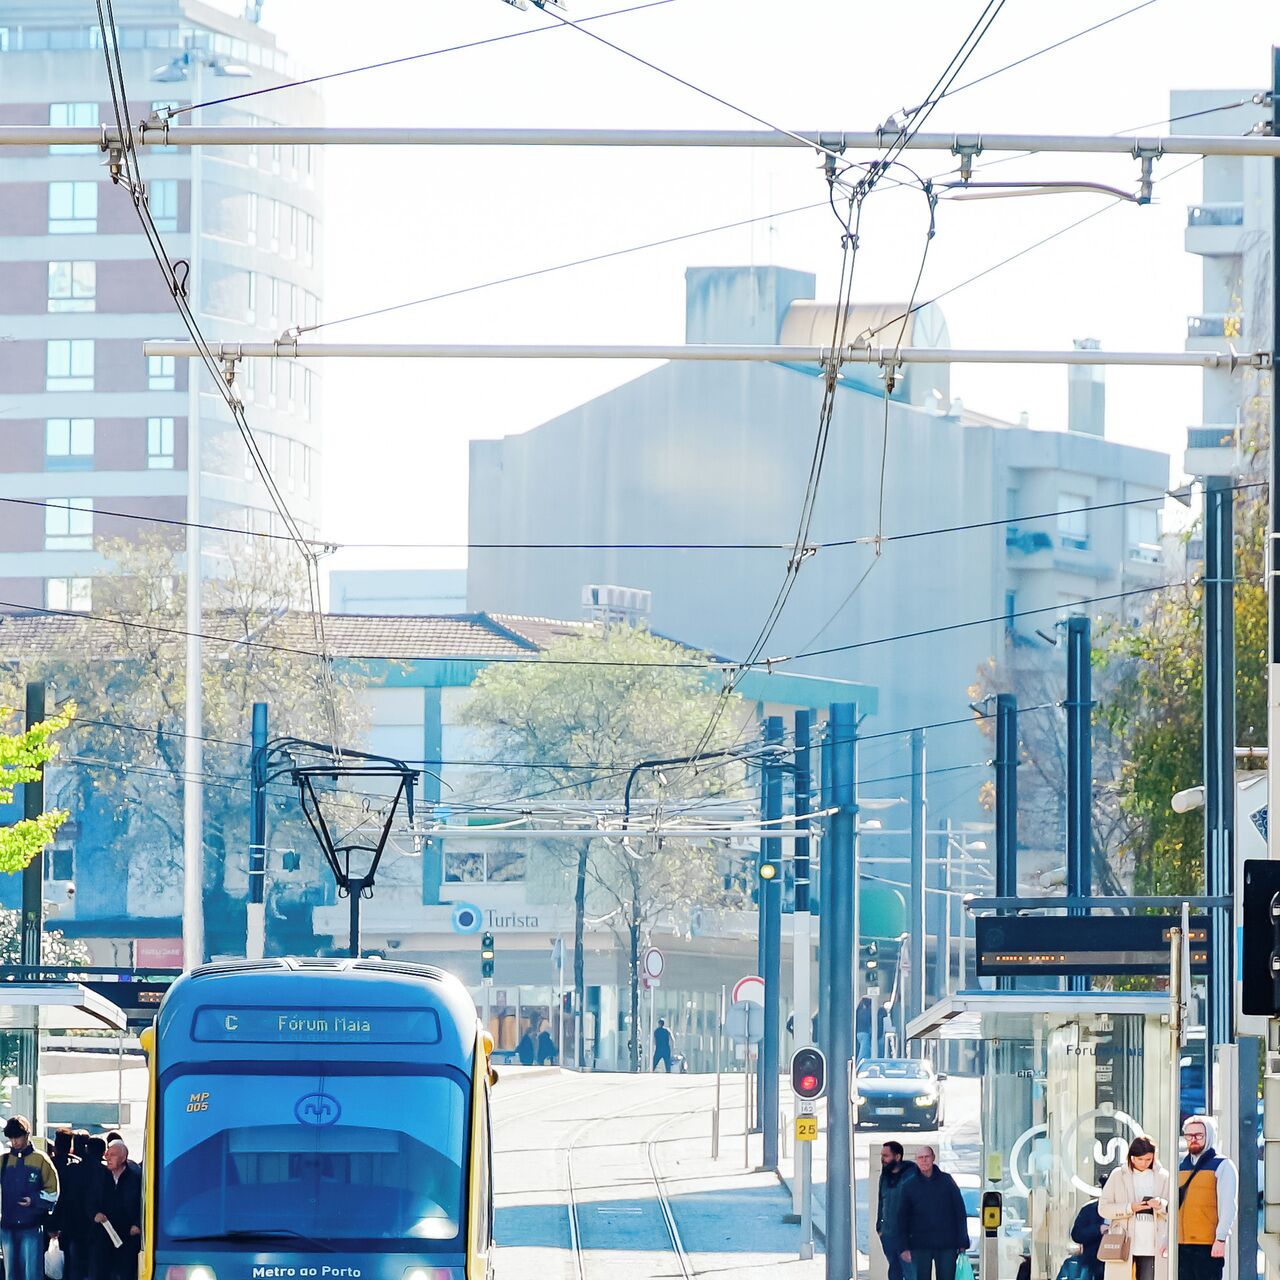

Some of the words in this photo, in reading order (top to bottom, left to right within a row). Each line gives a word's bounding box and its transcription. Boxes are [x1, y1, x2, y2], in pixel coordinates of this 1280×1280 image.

[484, 909, 539, 928] Turista
[224, 1015, 239, 1031] C
[277, 1014, 328, 1031] Fórum
[334, 1016, 371, 1032] Maia
[189, 1092, 210, 1103] MP
[186, 1102, 209, 1113] 005
[799, 1125, 815, 1134] 25
[252, 1267, 296, 1279] Metro
[321, 1266, 361, 1278] Porto
